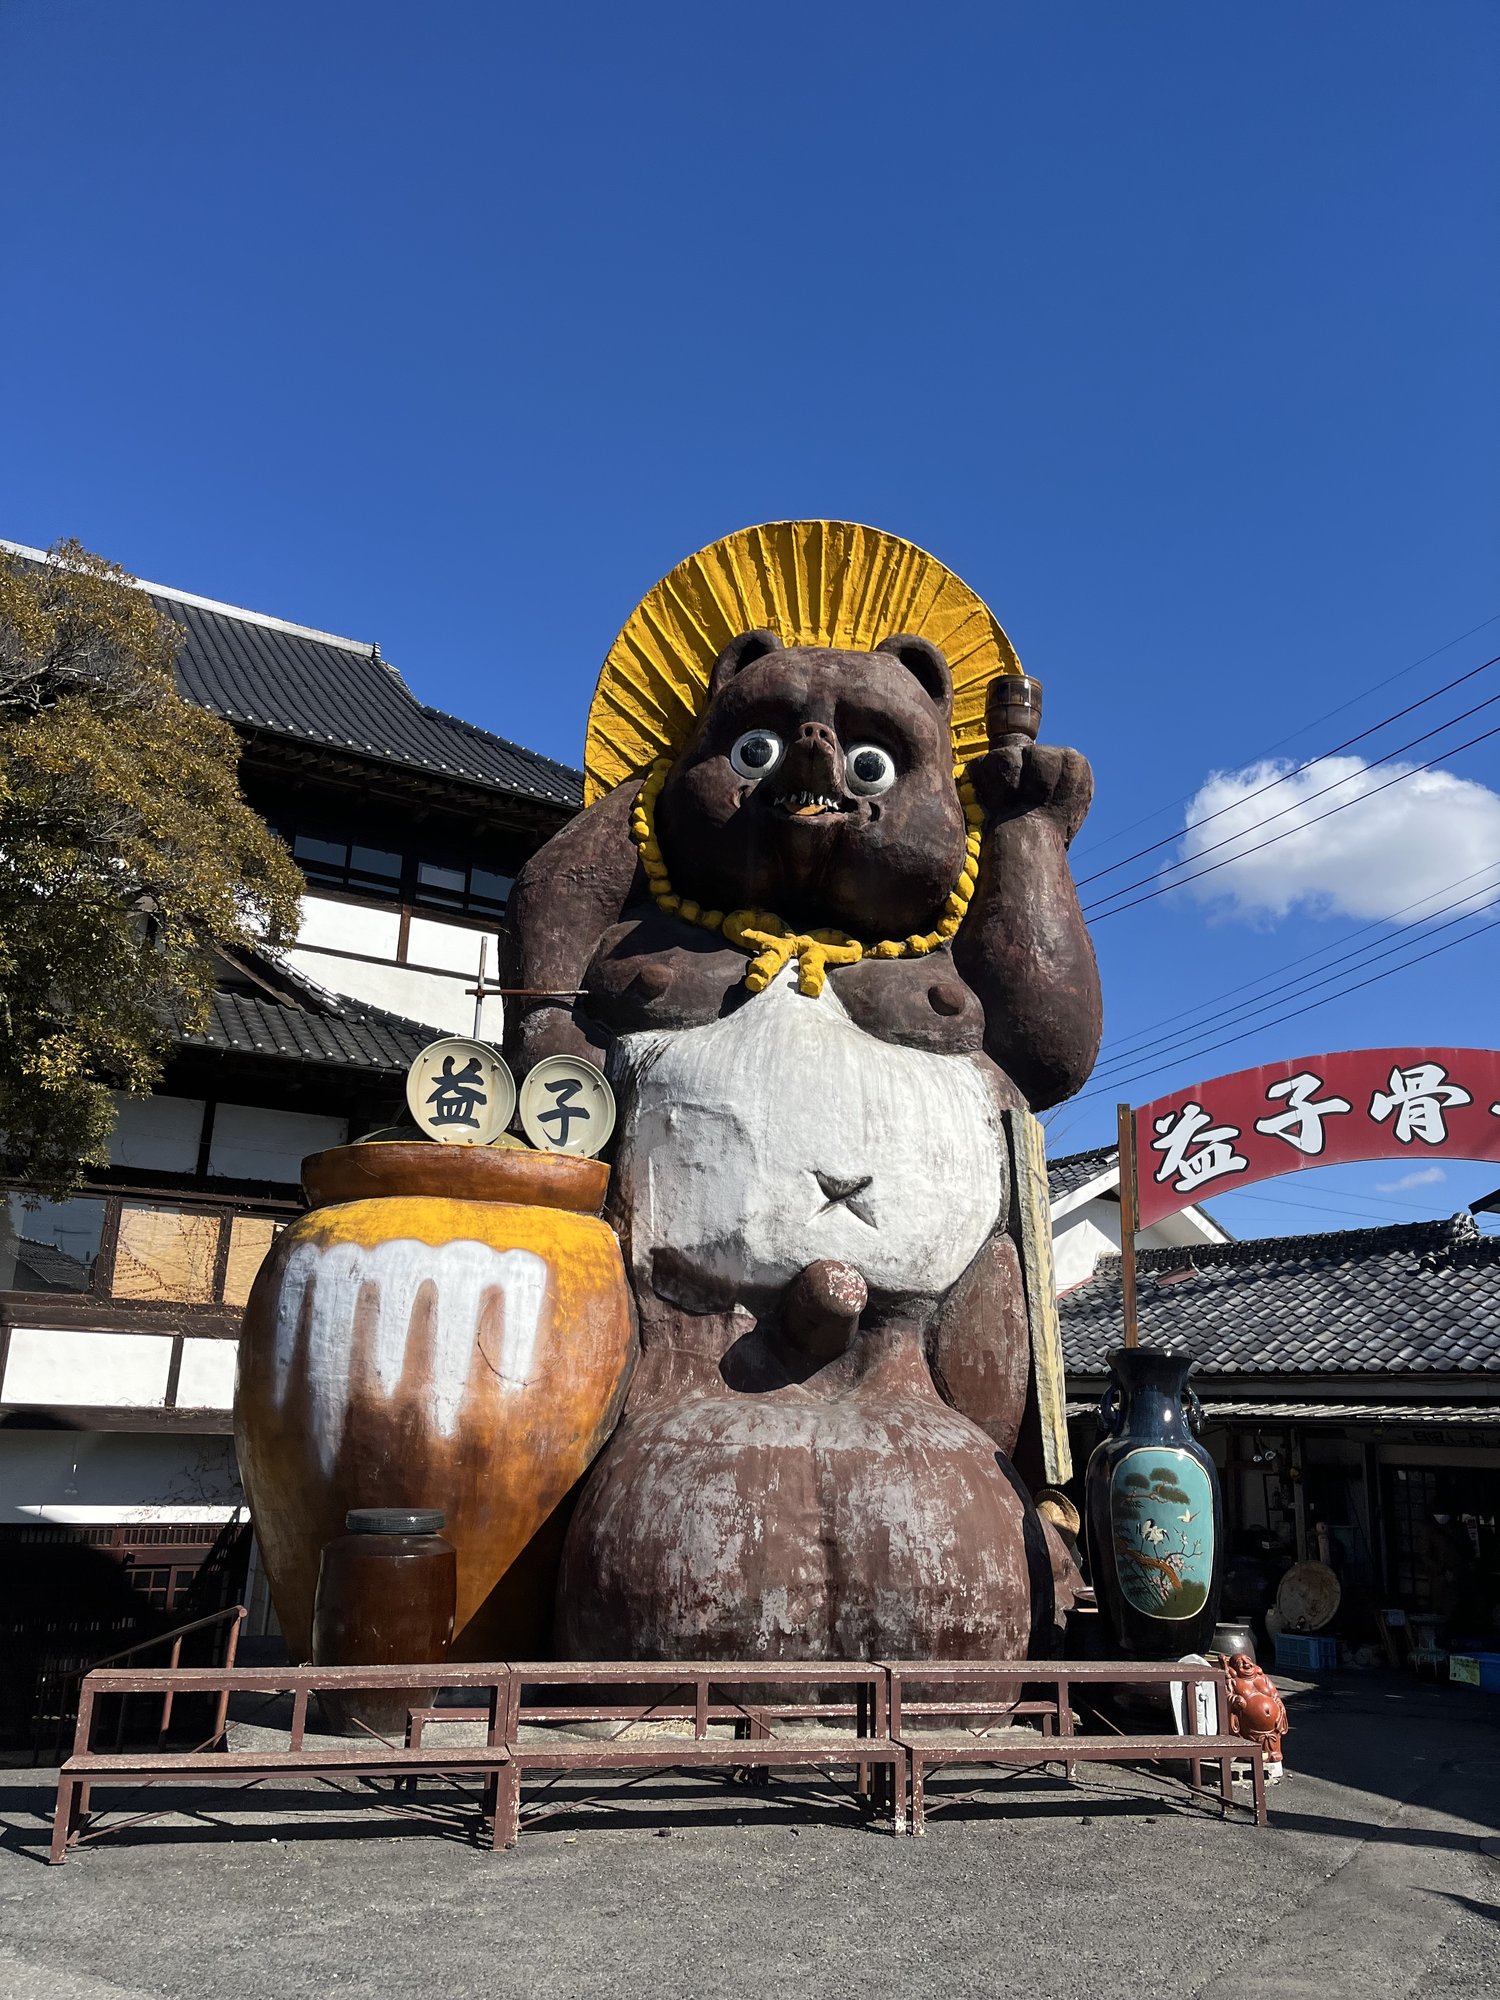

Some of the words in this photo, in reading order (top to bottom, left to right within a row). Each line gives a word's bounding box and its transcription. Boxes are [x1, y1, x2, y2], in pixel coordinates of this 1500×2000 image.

[426, 1056, 590, 1147] 益子
[1151, 1061, 1500, 1192] 益子骨
